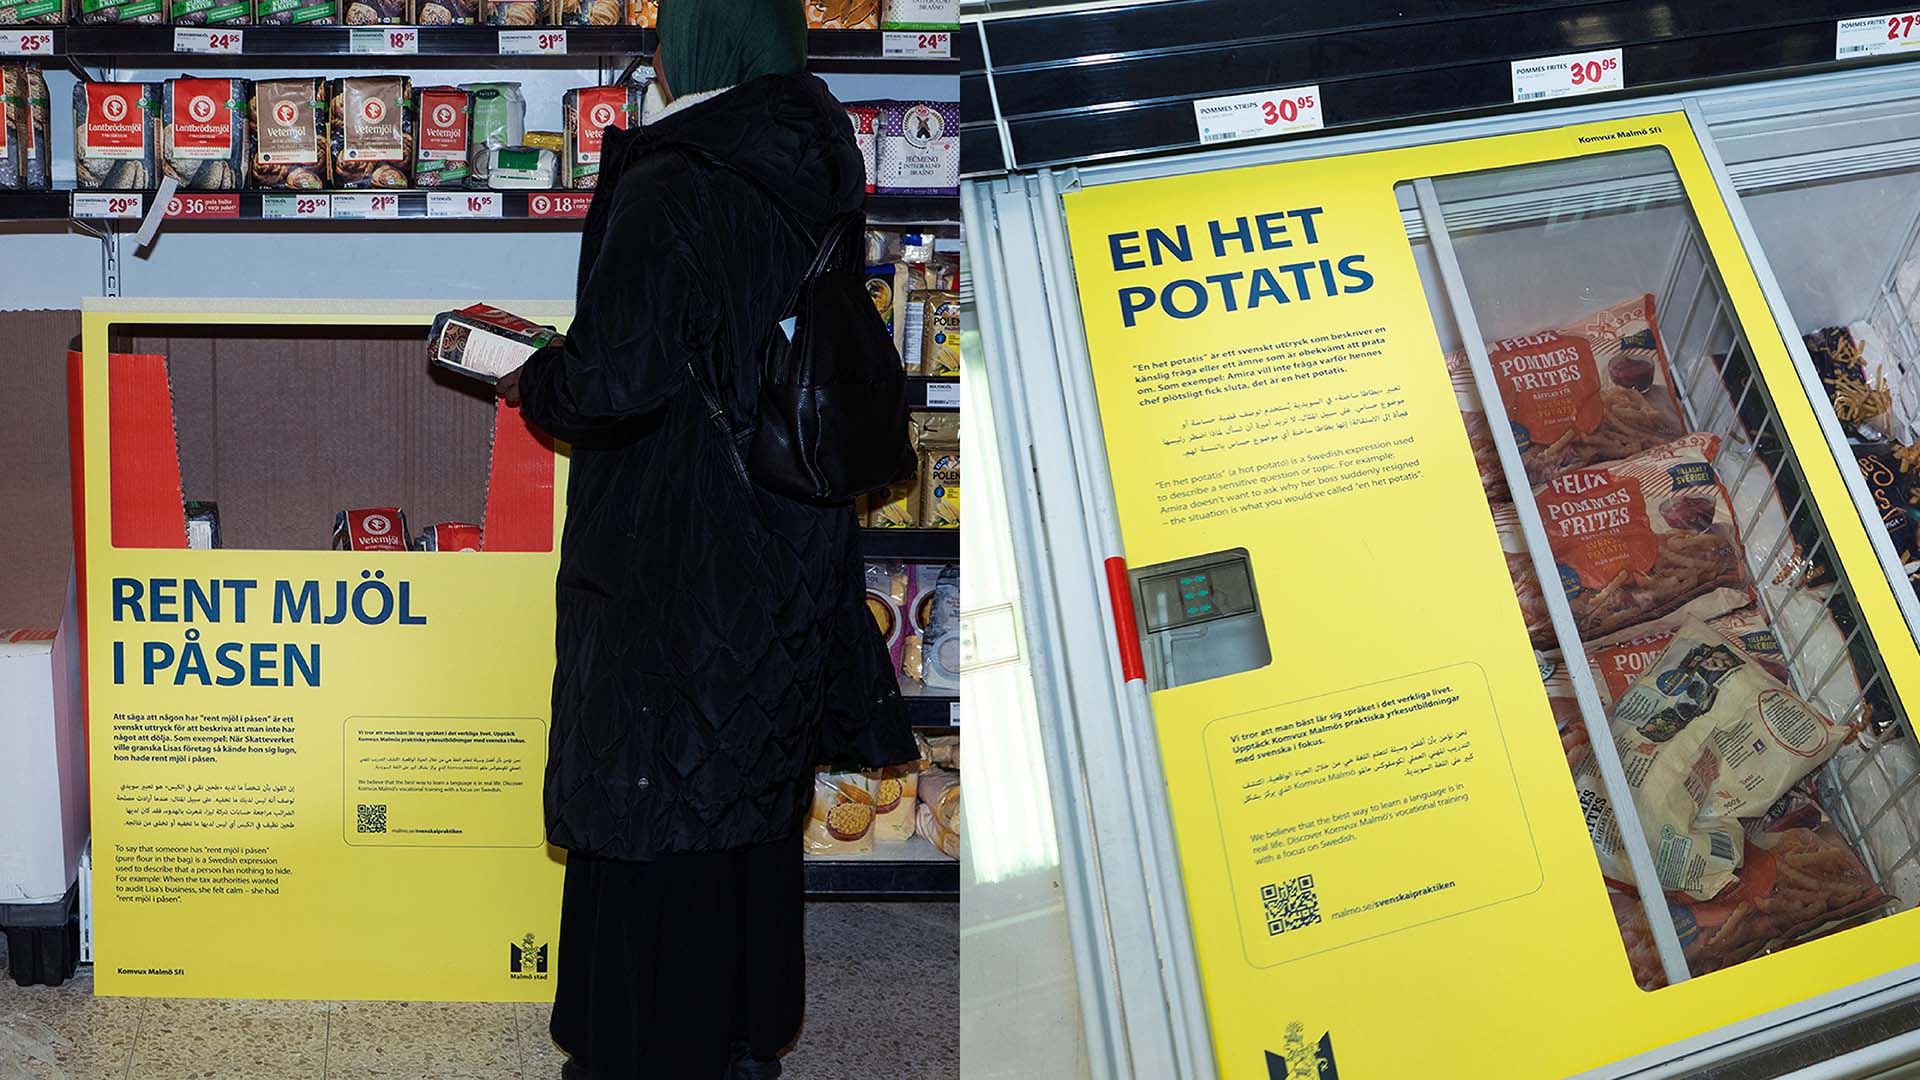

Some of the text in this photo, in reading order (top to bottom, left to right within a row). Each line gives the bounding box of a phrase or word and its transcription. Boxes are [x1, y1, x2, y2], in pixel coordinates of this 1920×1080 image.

[1867, 18, 1886, 26] FRITES
[1516, 63, 1568, 75] POMMES FRITES
[1200, 102, 1258, 114] POMMES STRIPS
[88, 123, 141, 133] Lantbrödsmjöl
[175, 124, 229, 134] Lantbrödsmjöl
[267, 127, 306, 138] Vetemjöl
[354, 124, 392, 135] Vetemjöl
[426, 128, 461, 138] Vetemjöl
[1578, 134, 1615, 143] Komvux
[1617, 129, 1647, 138] Malmö
[185, 199, 203, 213] 36
[554, 198, 572, 212] 18
[1108, 206, 1324, 271] EN HET
[1117, 254, 1375, 328] POTATIS
[1501, 331, 1559, 352] FELIX
[1152, 361, 1168, 369] het
[1170, 354, 1207, 368] potatis"
[1238, 345, 1273, 355] svenskt
[1275, 338, 1308, 351] uttryck
[1330, 330, 1372, 340] beskriver
[1135, 372, 1170, 383] känslig
[1172, 369, 1197, 377] fråga
[1199, 365, 1219, 373] eller
[1238, 358, 1264, 366] ämne
[1266, 354, 1285, 362] som
[1299, 344, 1345, 356] obekvämt
[1362, 338, 1385, 348] prata
[1500, 346, 1580, 377] POMMES
[1158, 383, 1180, 391] Som
[1181, 374, 1225, 389] exempel:
[1228, 371, 1255, 380] Amira
[1257, 366, 1272, 374] vill
[1293, 360, 1318, 368] fråga
[1319, 354, 1347, 364] varför
[1348, 350, 1382, 360] hennes
[1511, 364, 1582, 393] FRITES
[1139, 396, 1160, 406] chef
[1162, 390, 1203, 404] plötsligt
[1204, 386, 1222, 395] fick
[1224, 384, 1250, 392] sluta,
[1252, 379, 1268, 388] det
[1294, 372, 1310, 380] het
[1312, 366, 1347, 378] potatis.
[1551, 472, 1609, 494] FELIX
[1547, 487, 1631, 520] POMMES
[1558, 507, 1631, 538] FRITES
[358, 535, 399, 546] Vetemjöl
[112, 569, 427, 625] RENT MJÖL
[113, 628, 321, 687] I PÅSEN
[1613, 650, 1660, 672] POM
[127, 714, 145, 722] säga
[159, 714, 184, 723] någon
[200, 714, 220, 722] "rent
[221, 715, 238, 724] mjöl
[244, 715, 271, 724] påsen"
[144, 724, 173, 732] uttryck
[174, 724, 185, 732] för
[114, 734, 136, 742] något
[150, 734, 172, 743] dölja.
[174, 734, 191, 742] Som
[192, 735, 228, 744] exempel:
[131, 744, 162, 753] granska
[163, 744, 182, 752] Lisas
[183, 744, 211, 754] företag
[265, 746, 276, 755] sig
[277, 746, 296, 755] lugn,
[169, 755, 186, 764] mjöl
[192, 755, 217, 764] påsen.
[1332, 881, 1455, 919] malmo.se/svenskaipraktiken
